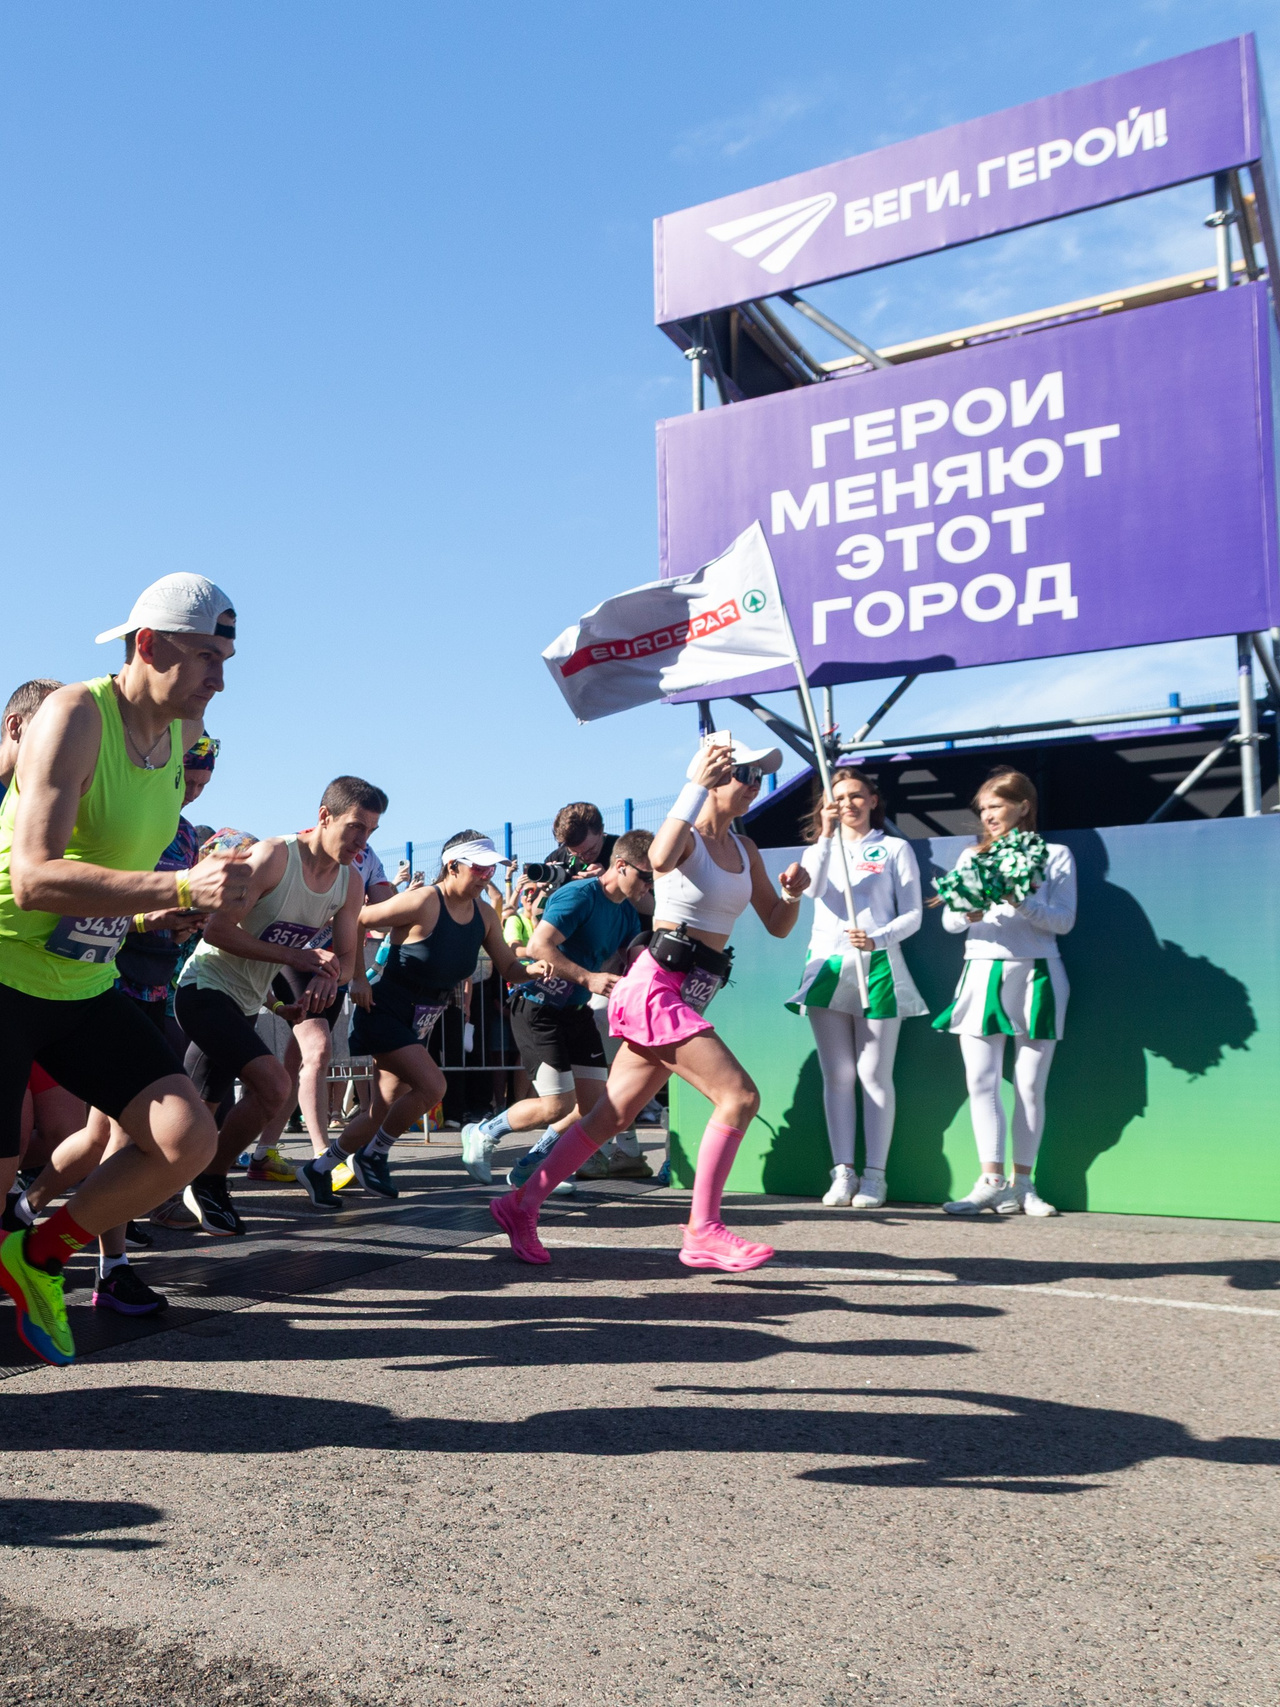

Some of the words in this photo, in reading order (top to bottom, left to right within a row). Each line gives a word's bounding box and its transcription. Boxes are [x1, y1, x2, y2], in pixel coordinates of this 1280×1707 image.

[844, 169, 972, 237] БЕГИ,
[977, 105, 1168, 198] ГЕРОЙ!
[811, 371, 1065, 469] ГЕРОИ
[771, 423, 1120, 535] МЕНЯЮТ
[835, 502, 1045, 581] ЭТОТ
[591, 604, 737, 660] EUROSPAR
[812, 562, 1079, 646] ГОРОД
[268, 928, 308, 948] 3512
[549, 976, 568, 994] 52
